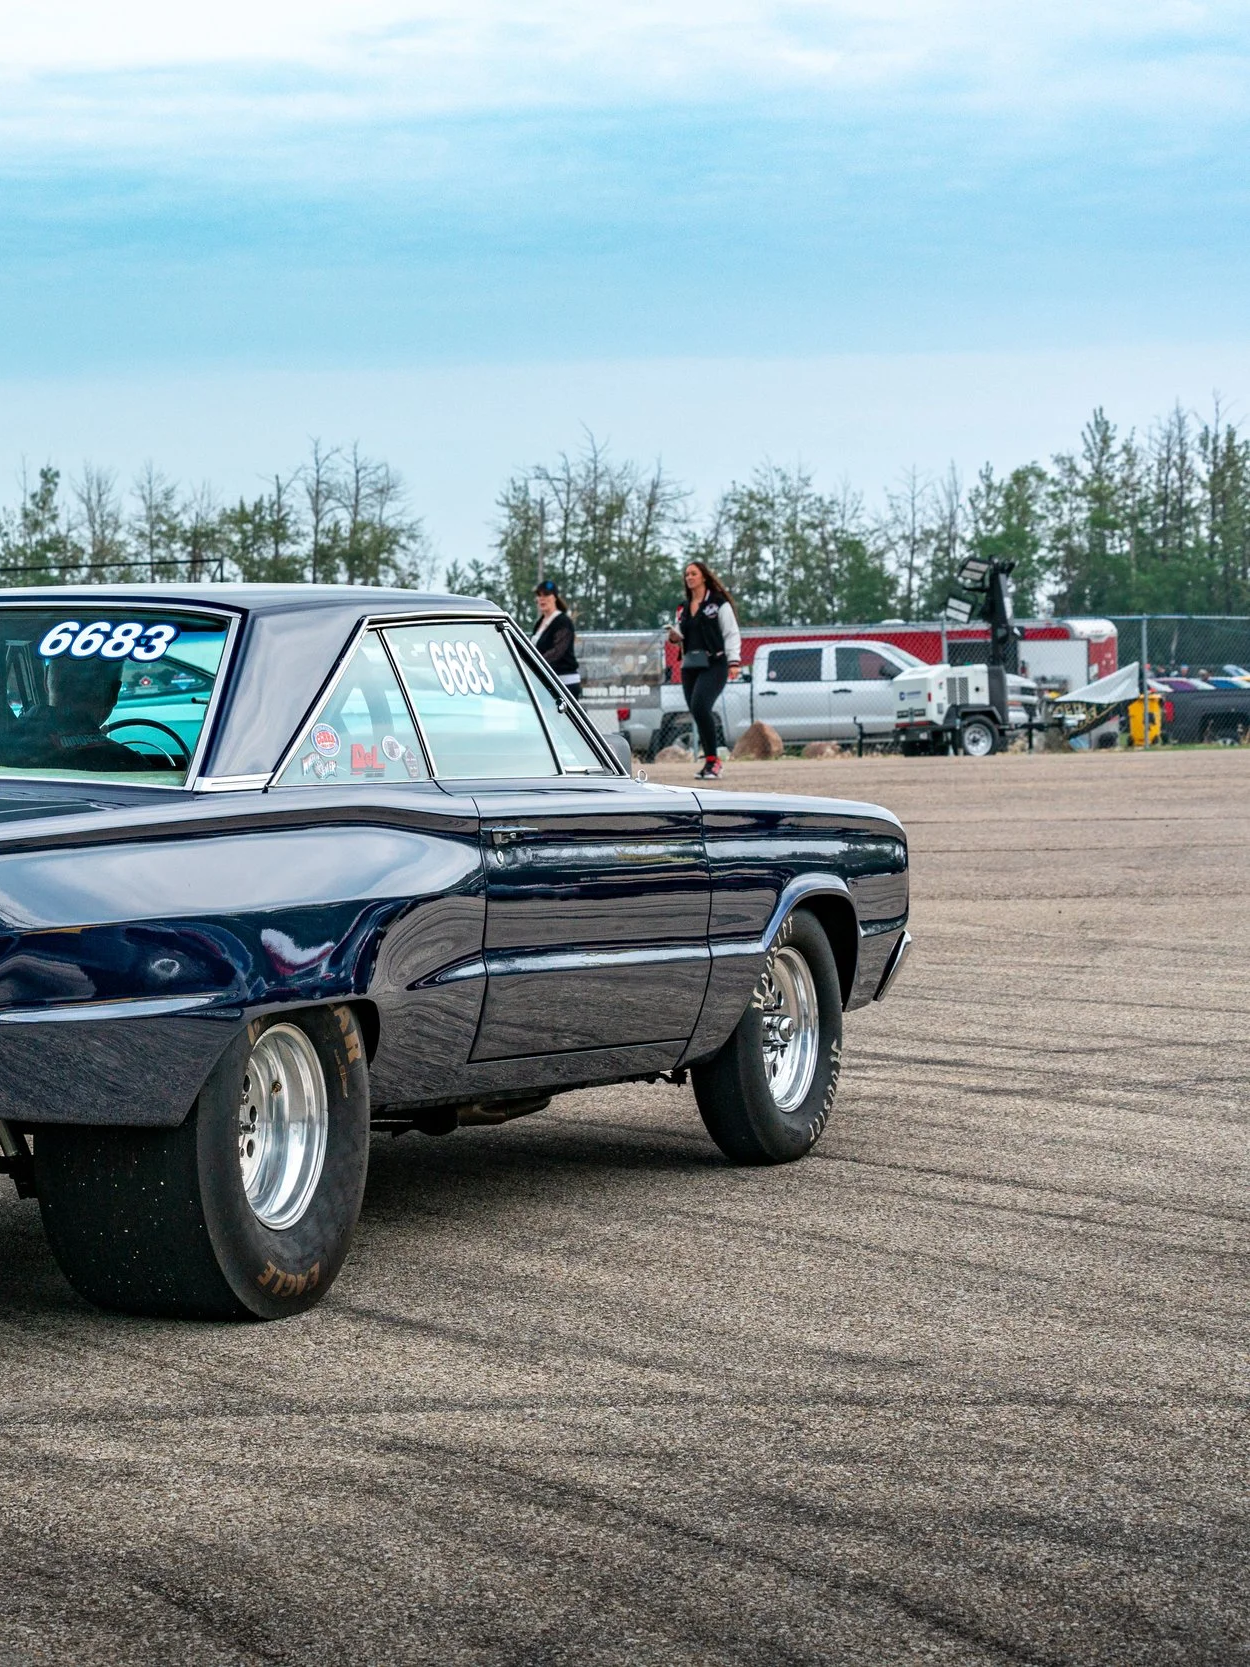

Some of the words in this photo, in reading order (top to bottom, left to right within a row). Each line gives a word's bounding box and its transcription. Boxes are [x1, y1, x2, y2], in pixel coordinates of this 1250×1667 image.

[39, 621, 176, 661] 6683
[428, 640, 495, 696] 6683
[582, 687, 608, 696] move
[609, 685, 625, 696] the
[626, 684, 650, 696] Earth
[257, 1260, 320, 1298] EAGLE
